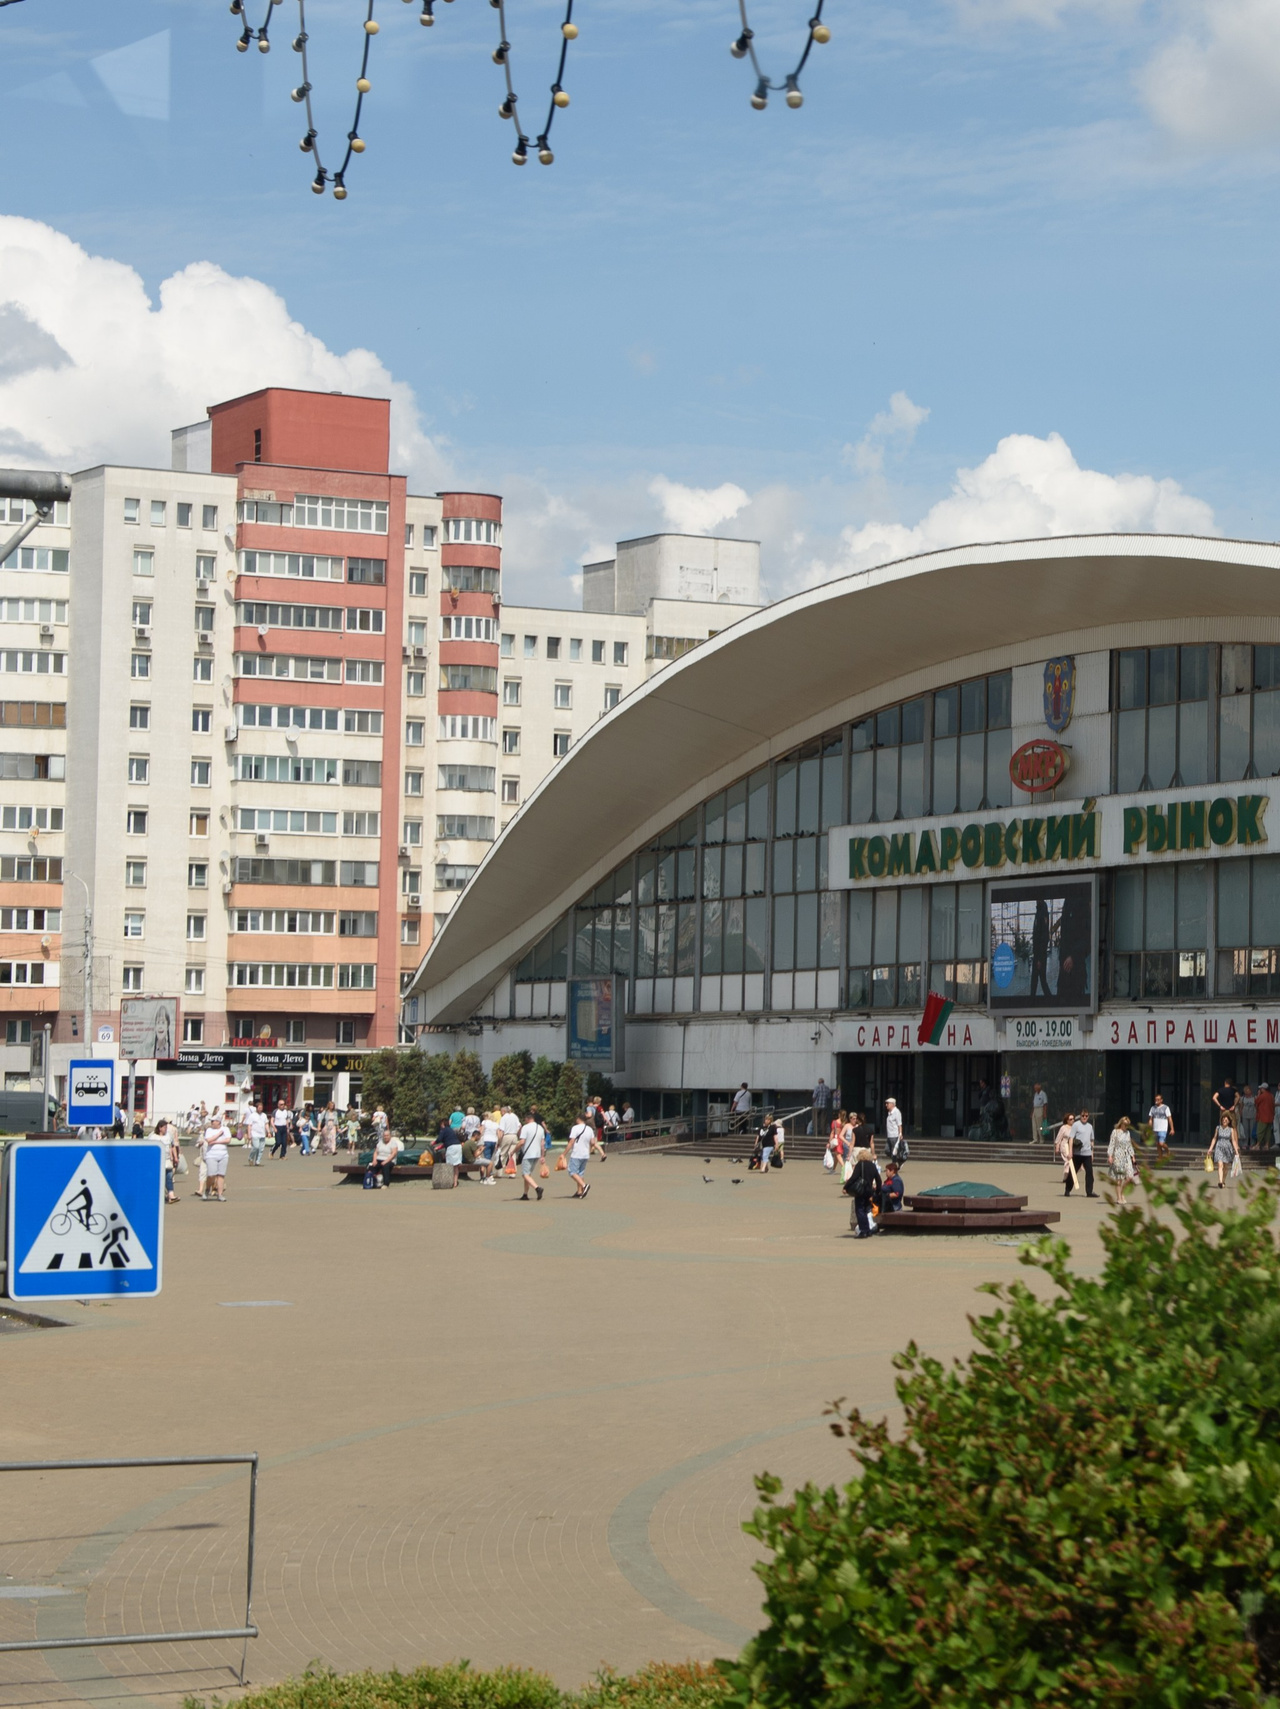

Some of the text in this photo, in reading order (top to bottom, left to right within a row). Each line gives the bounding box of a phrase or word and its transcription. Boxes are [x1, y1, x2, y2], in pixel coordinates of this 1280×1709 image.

[1018, 751, 1058, 781] МКР
[849, 795, 1268, 879] КОМАРОВСКИЙ РЫНОК
[857, 1019, 1279, 1049] САРДНА ЗАПРАШАЕМ
[1016, 1020, 1036, 1037] 9.00
[1046, 1020, 1072, 1037] 19.00
[101, 1032, 111, 1041] 69
[1016, 1038, 1039, 1048] ВЫХОДНОЙ
[1042, 1039, 1072, 1048] ПОНЕДЕЛЬНИК
[177, 1053, 224, 1062] Зима Лето
[256, 1053, 304, 1063] Зима Лето
